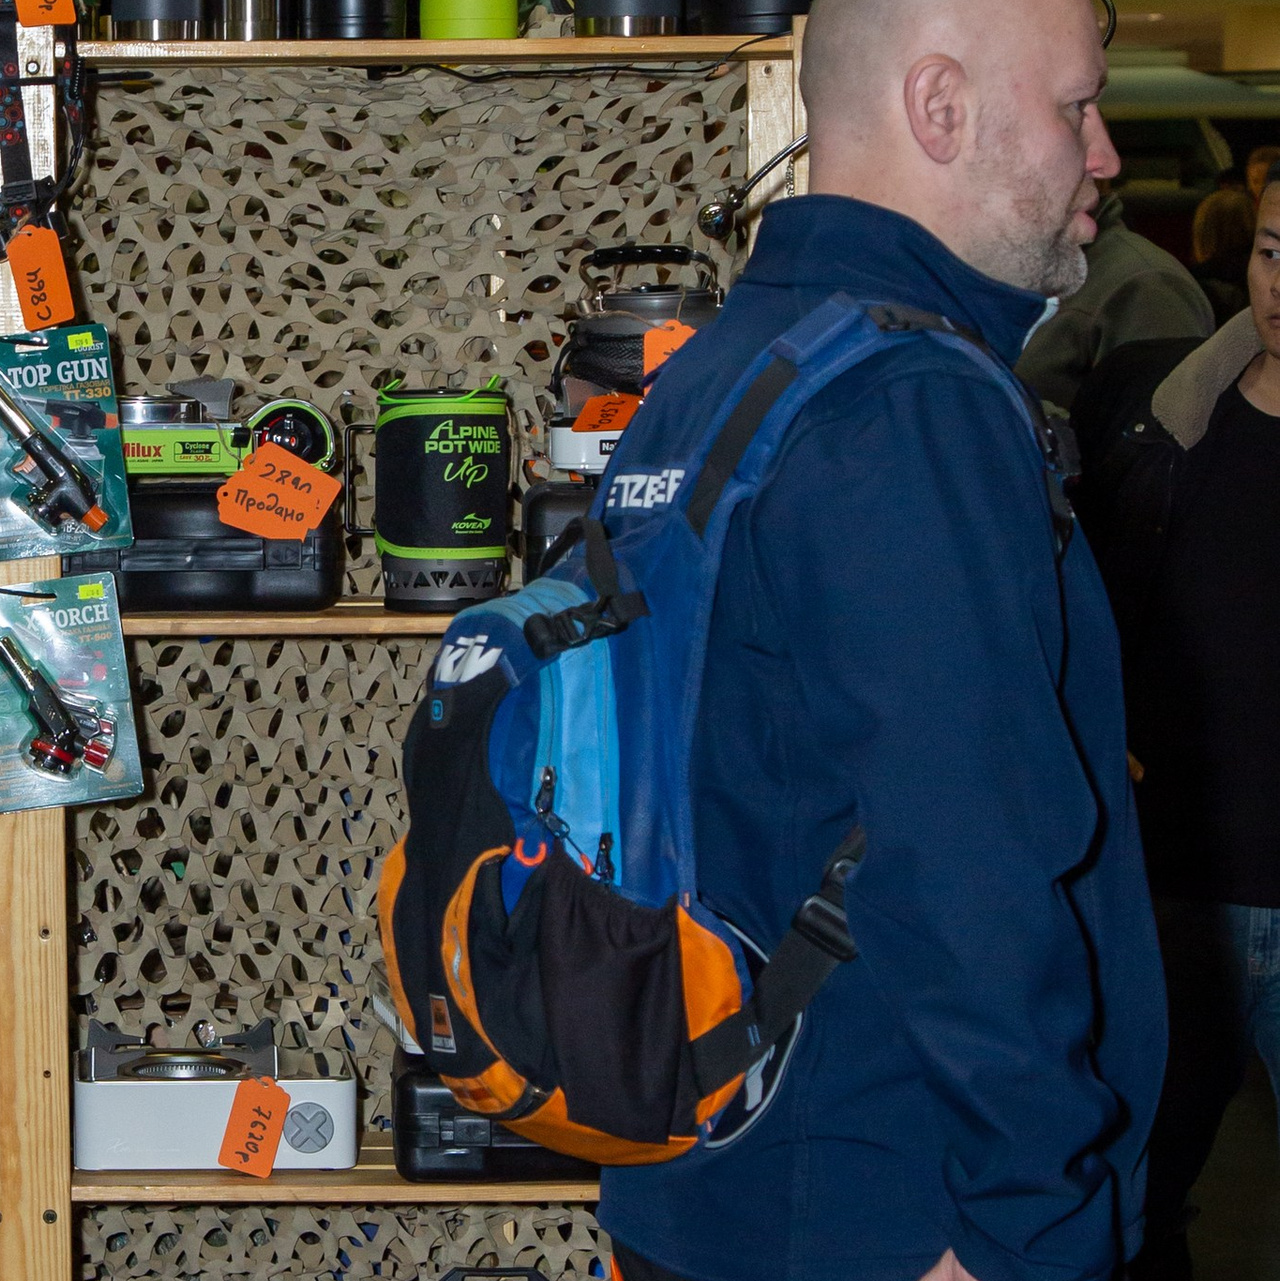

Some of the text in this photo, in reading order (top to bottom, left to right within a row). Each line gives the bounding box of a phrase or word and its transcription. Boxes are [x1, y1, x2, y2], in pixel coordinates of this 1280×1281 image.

[7, 356, 108, 389] TOP GUN
[63, 386, 112, 401] TT-330
[429, 419, 499, 440] ALPINE
[184, 442, 211, 452] Cyclone
[424, 440, 501, 454] POT WIDE
[451, 521, 484, 530] KOVEA
